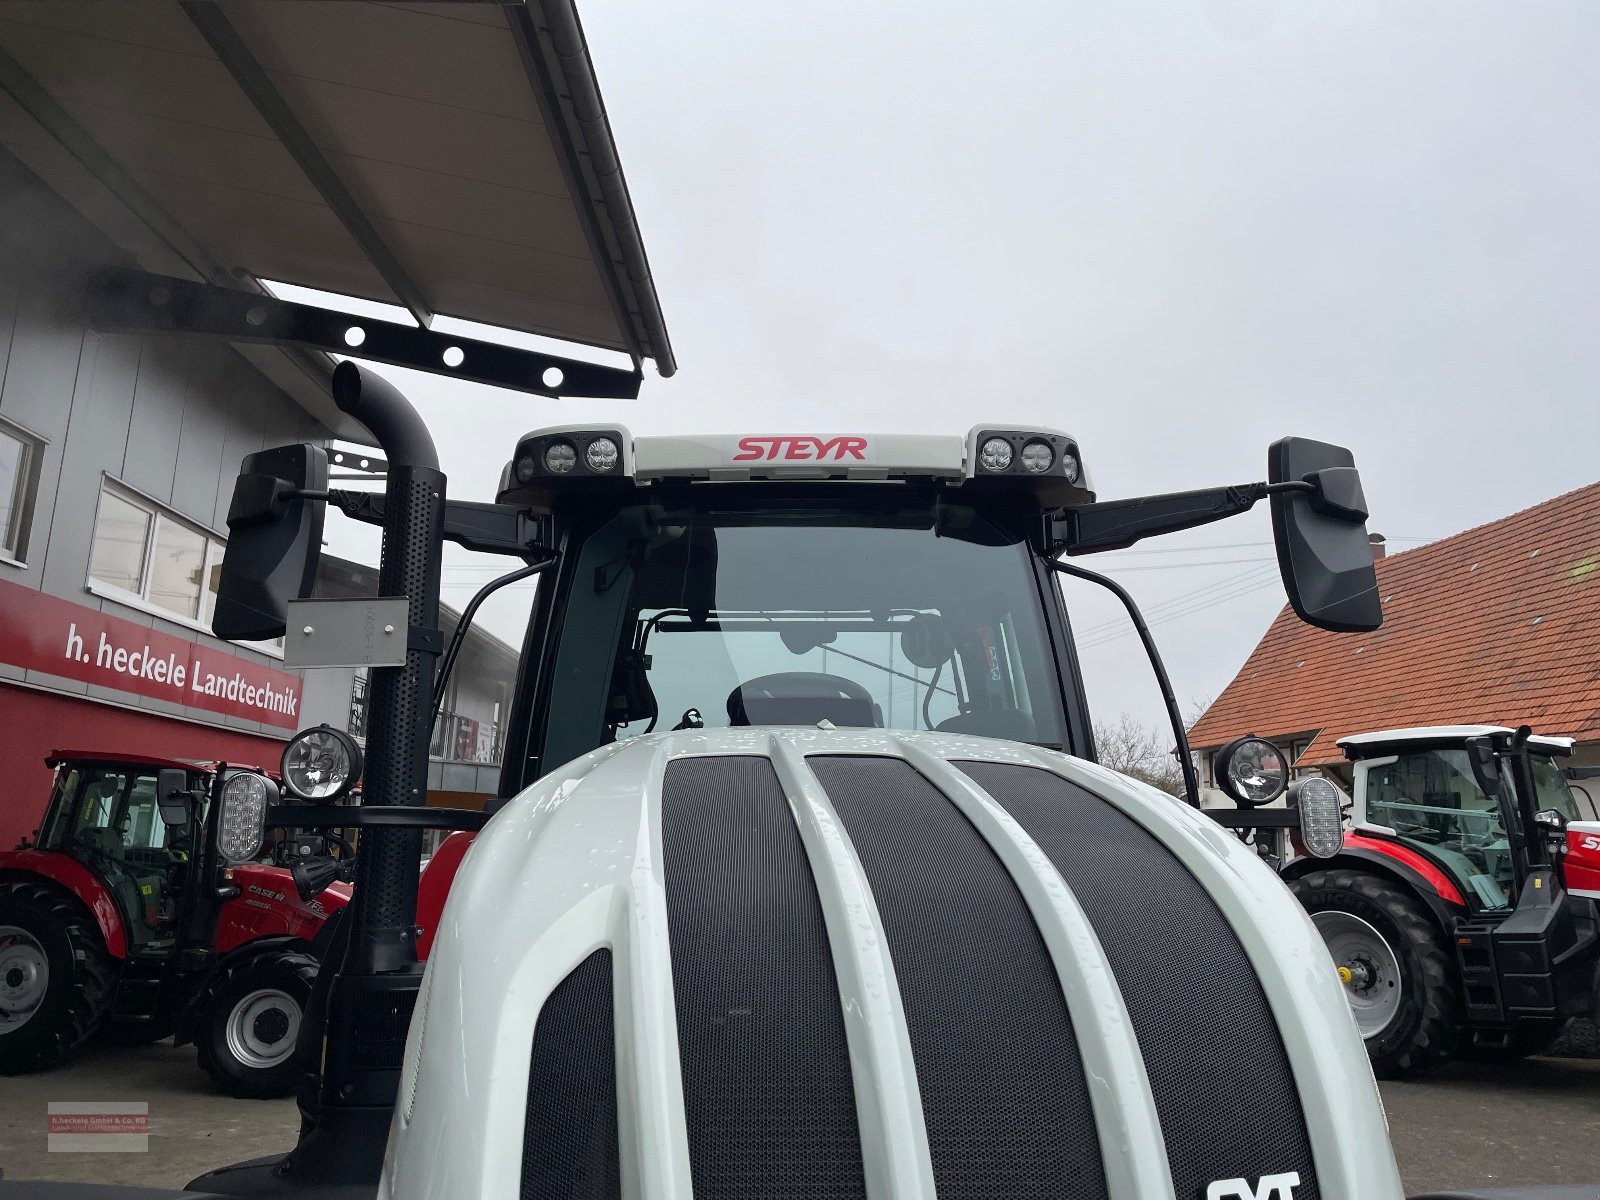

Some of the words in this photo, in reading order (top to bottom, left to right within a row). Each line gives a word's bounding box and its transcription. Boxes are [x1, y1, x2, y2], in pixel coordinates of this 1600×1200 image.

[733, 436, 868, 460] STEYR
[65, 622, 90, 664] h.
[96, 631, 186, 687] heckele
[191, 660, 298, 717] Landtechnik
[248, 884, 275, 899] CASE
